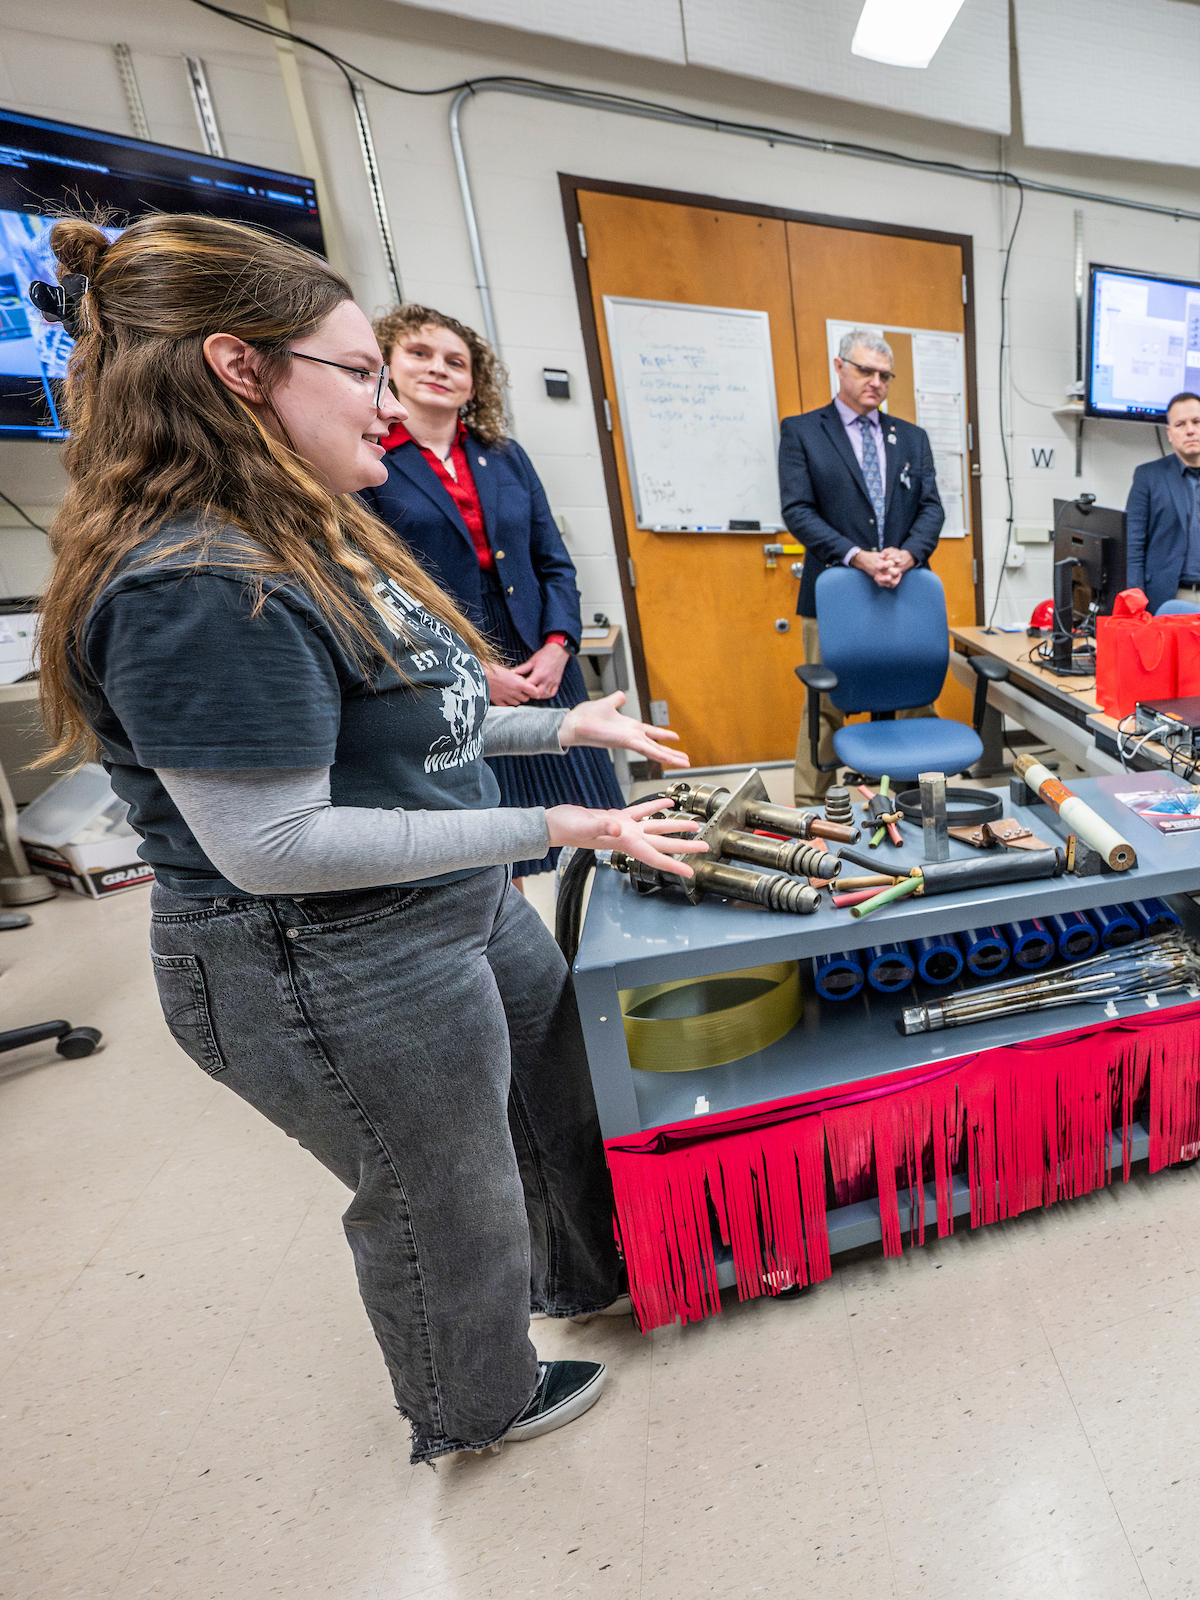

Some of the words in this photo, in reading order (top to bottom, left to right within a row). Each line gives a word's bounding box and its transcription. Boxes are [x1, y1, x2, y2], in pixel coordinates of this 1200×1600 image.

[1031, 448, 1054, 468] W
[410, 649, 443, 672] EST.
[424, 747, 464, 774] WILD,
[101, 865, 155, 886] GRAIN
